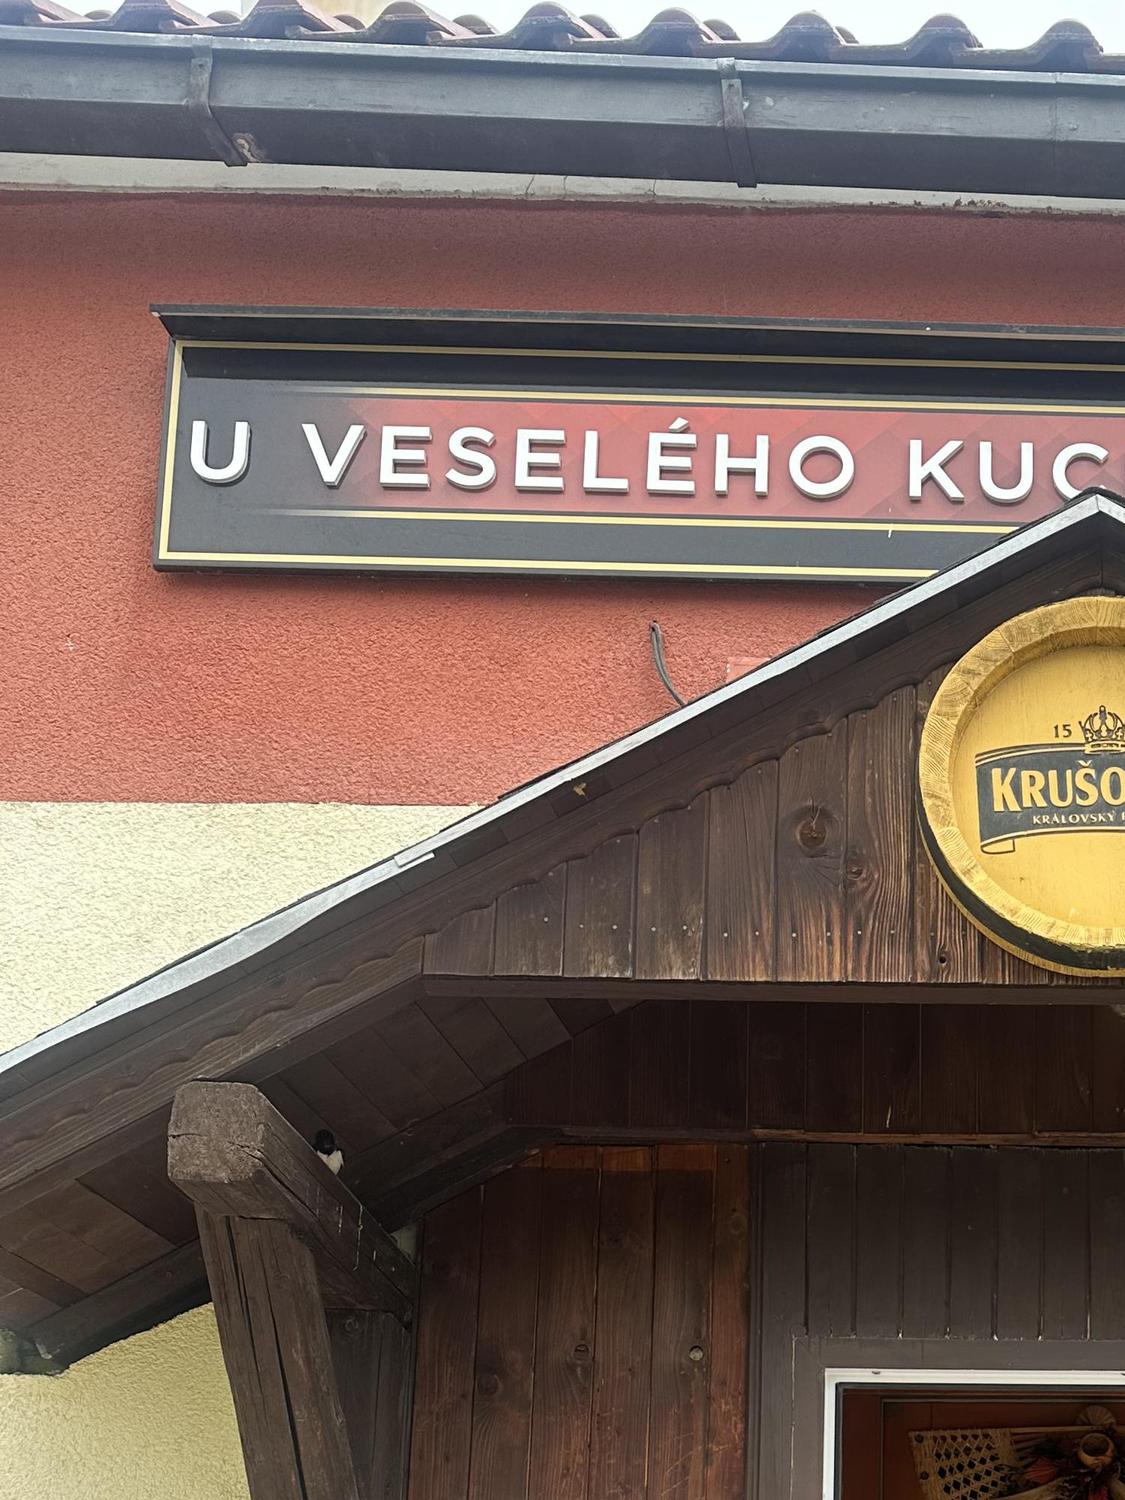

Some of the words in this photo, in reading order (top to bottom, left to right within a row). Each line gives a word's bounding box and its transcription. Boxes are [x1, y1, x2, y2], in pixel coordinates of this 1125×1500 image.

[189, 420, 252, 486] U
[302, 416, 856, 499] VESELÉHO
[1054, 724, 1072, 738] 15
[1032, 810, 1117, 825] KRÁLOVSKÝ
